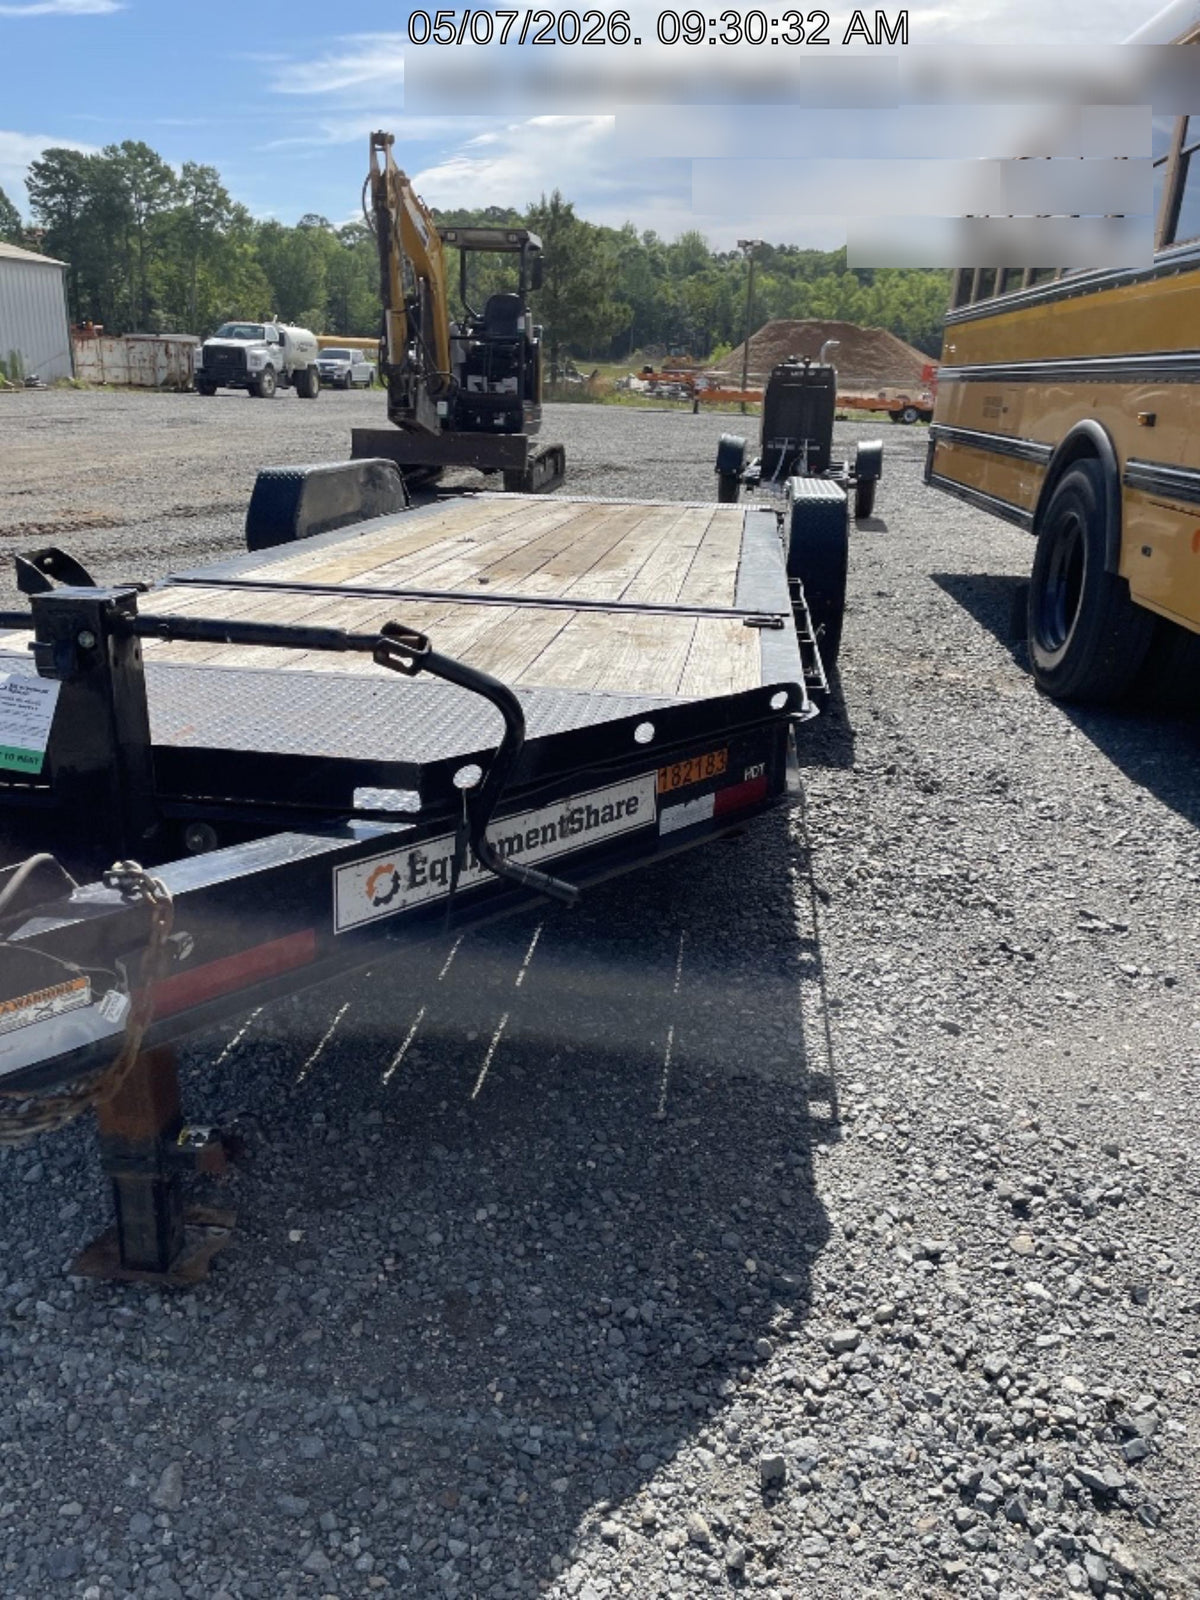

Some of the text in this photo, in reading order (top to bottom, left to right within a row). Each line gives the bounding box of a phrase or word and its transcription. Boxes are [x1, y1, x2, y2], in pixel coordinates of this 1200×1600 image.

[660, 750, 727, 789] 182183
[744, 762, 766, 781] HDT
[406, 795, 640, 890] EqmentShare
